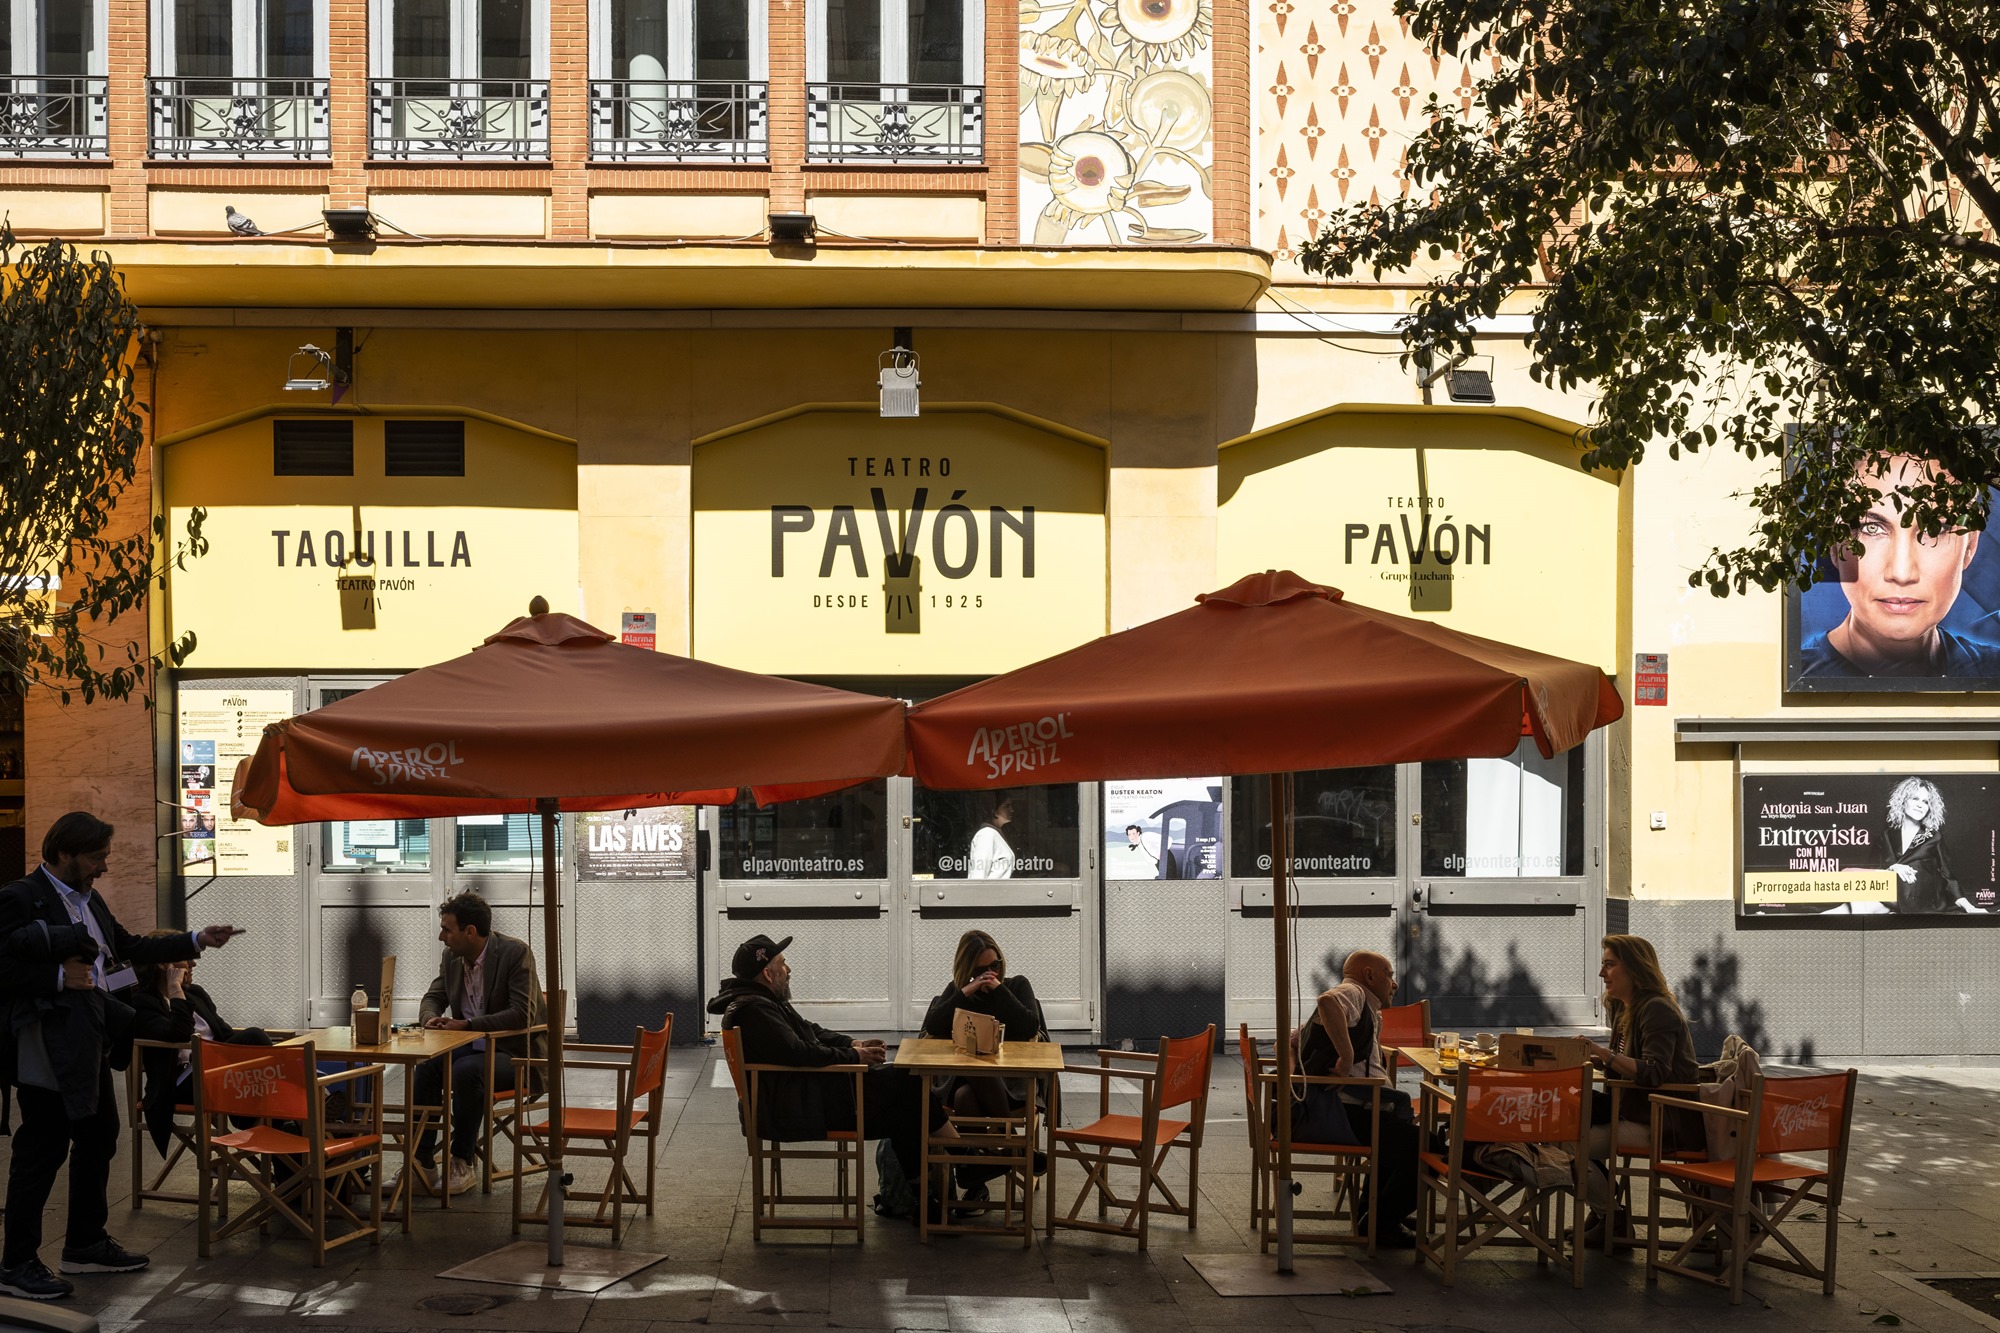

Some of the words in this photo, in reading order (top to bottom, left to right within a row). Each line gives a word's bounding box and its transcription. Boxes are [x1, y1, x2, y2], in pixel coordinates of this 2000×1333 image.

[848, 457, 952, 477] TEATRO
[1388, 497, 1445, 508] TEATRO
[770, 487, 1036, 579] PAVÓN
[1345, 514, 1491, 566] PAVÓN
[272, 530, 472, 568] TAQUILLA
[336, 579, 376, 590] TEATRO
[380, 577, 414, 590] PAVÓN
[1380, 572, 1412, 582] Grupo
[1414, 571, 1454, 580] Luchana
[814, 595, 869, 608] DESDE
[932, 594, 984, 608] 1925
[624, 634, 654, 642] Alarma
[967, 712, 1074, 766] APEROL
[350, 740, 464, 771] APEROL
[1760, 802, 1811, 814] Antonia
[1814, 804, 1832, 814] San
[1836, 802, 1868, 814] Juan
[588, 825, 626, 851] LAS
[632, 824, 683, 851] AVES
[1759, 824, 1870, 846] Entrevista
[1796, 848, 1812, 858] CON
[1815, 846, 1827, 858] MI
[742, 856, 864, 875] elpavonteatro.es
[1256, 854, 1371, 873] @pavonteatro
[1790, 859, 1808, 870] HIJA
[1810, 858, 1840, 872] MARI
[1753, 881, 1811, 894] ¡Prorrogada
[1814, 880, 1840, 891] hasta
[1844, 880, 1852, 891] el
[1855, 880, 1866, 890] 23
[1870, 880, 1889, 890] Abr!
[224, 1064, 286, 1089] APEROL
[1487, 1088, 1561, 1116] APEROL
[1773, 1094, 1830, 1128] APEROL
